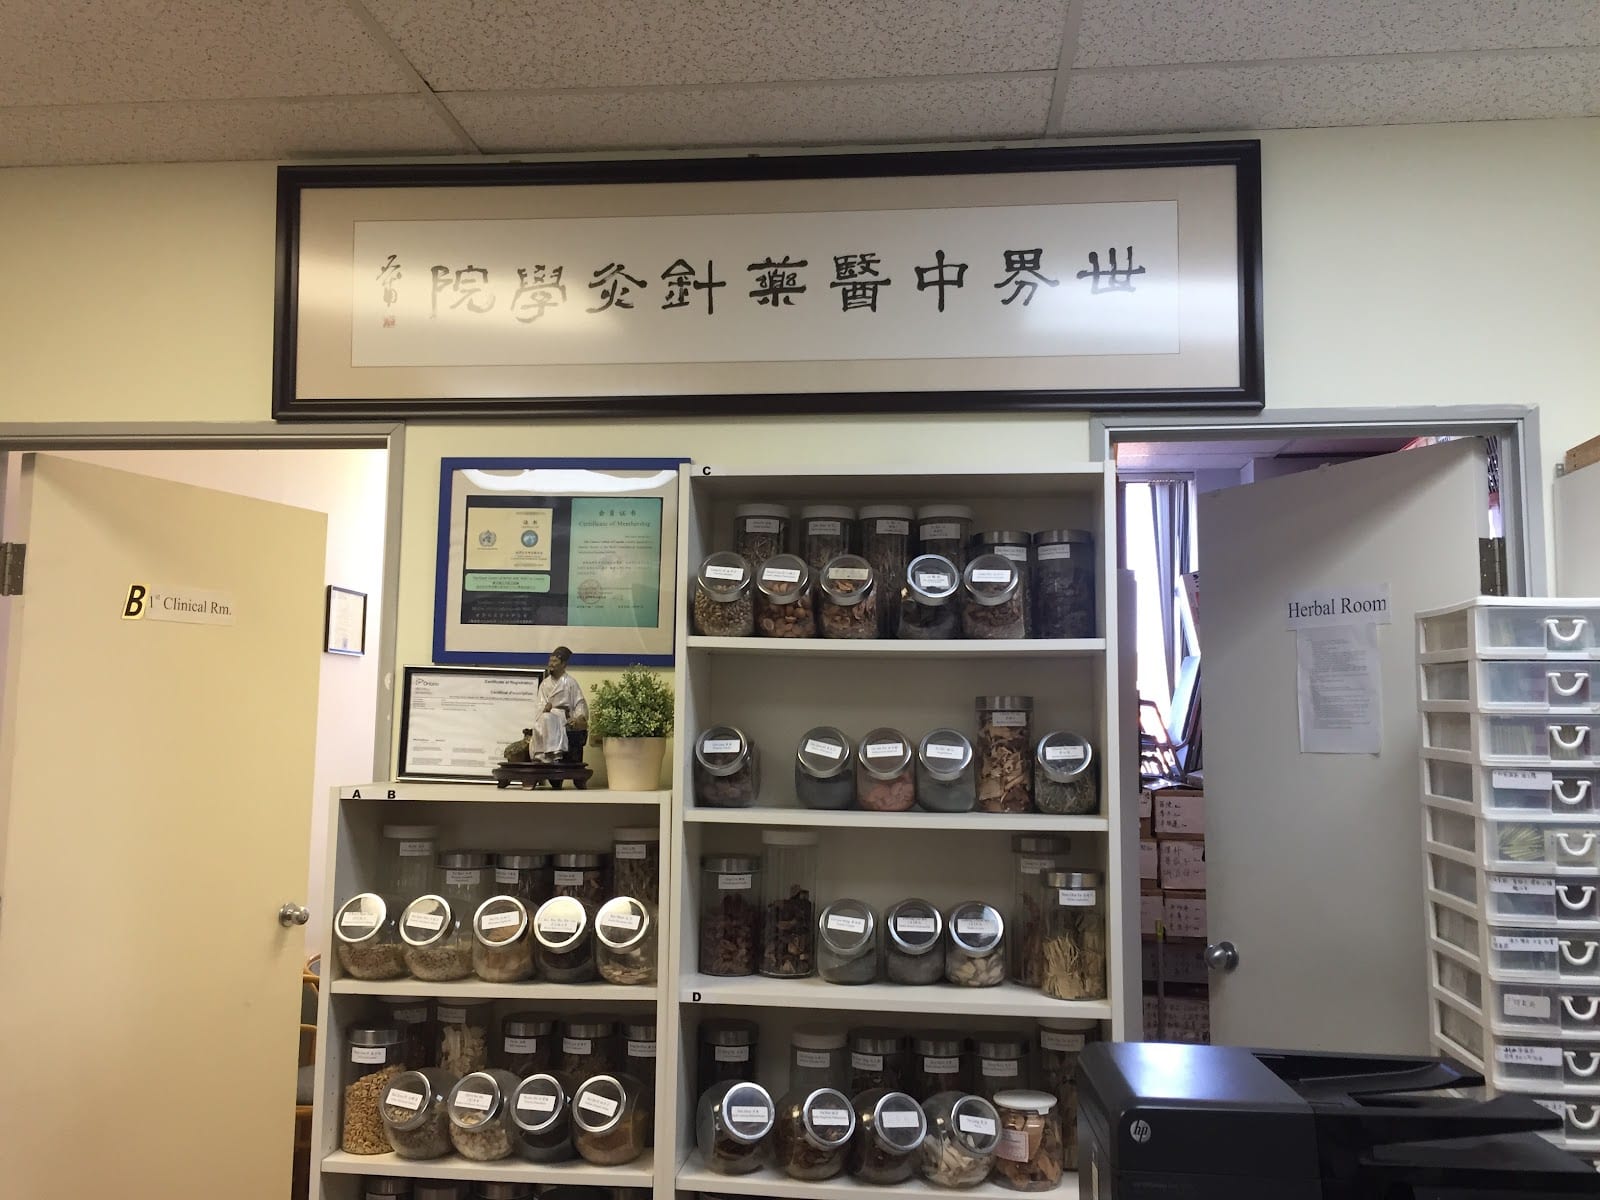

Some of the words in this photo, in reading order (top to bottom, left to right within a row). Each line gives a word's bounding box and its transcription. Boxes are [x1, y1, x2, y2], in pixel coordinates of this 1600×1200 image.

[702, 466, 711, 476] C
[124, 585, 146, 616] B
[163, 597, 207, 613] Clinical
[210, 601, 232, 615] Rm.
[1288, 599, 1335, 618] Herbal
[1341, 597, 1387, 614] Room
[352, 789, 361, 799] A
[387, 790, 396, 799] B
[692, 992, 702, 1002] D
[1131, 1120, 1150, 1143] hp
